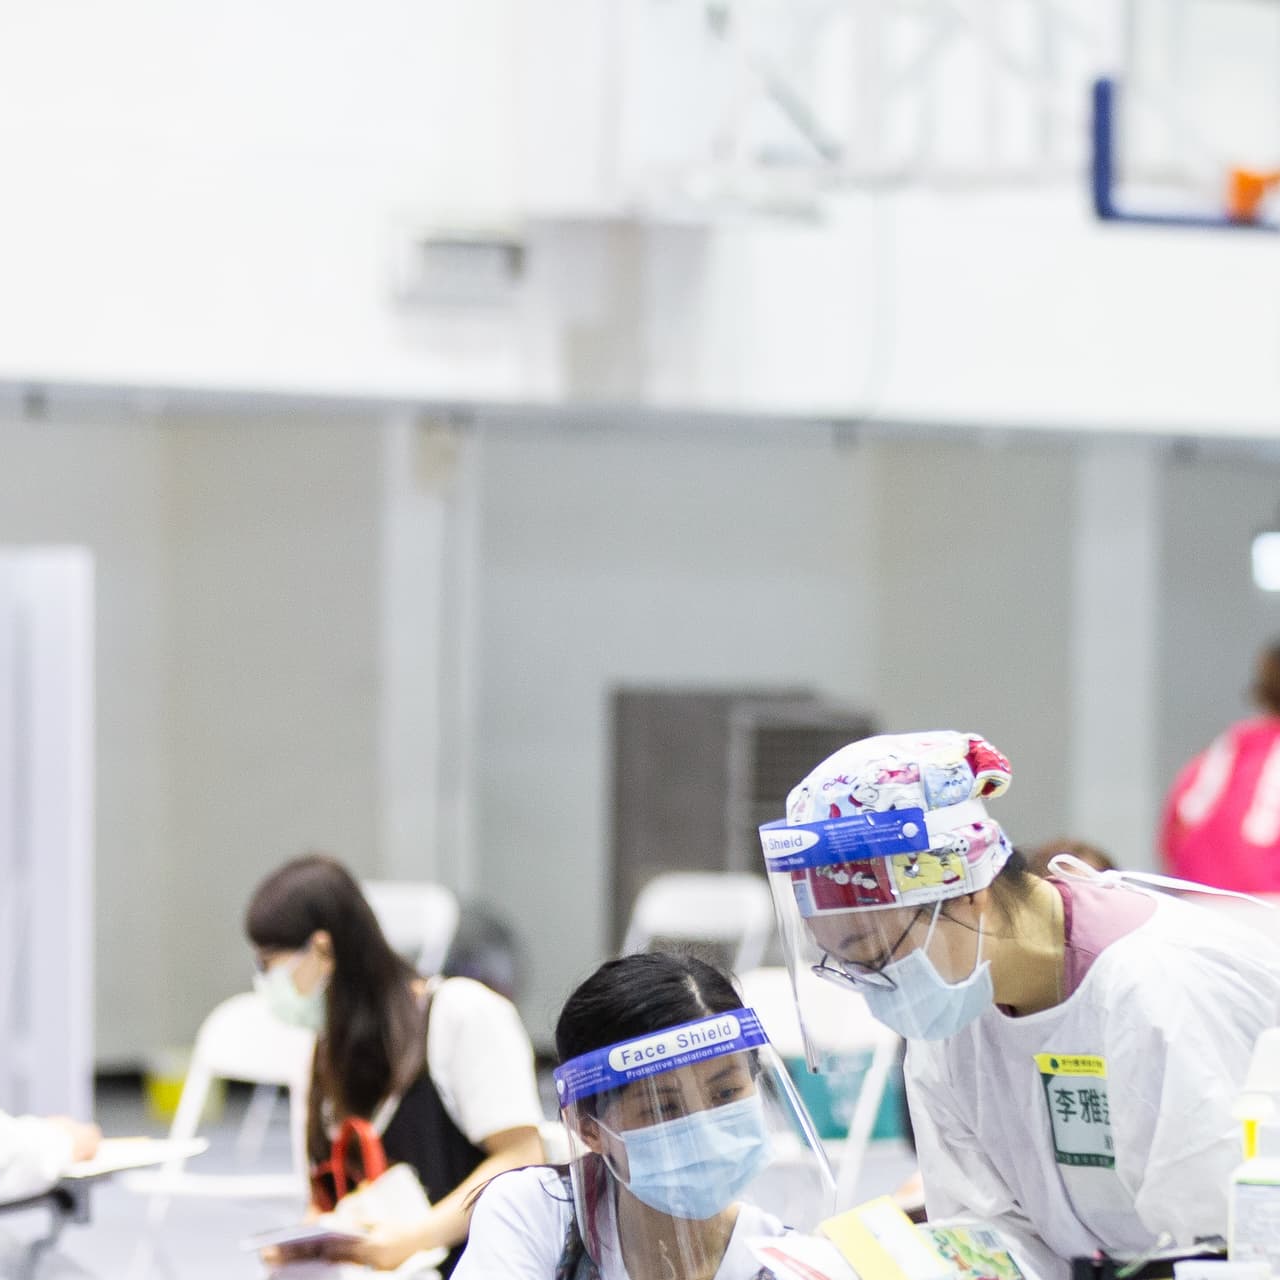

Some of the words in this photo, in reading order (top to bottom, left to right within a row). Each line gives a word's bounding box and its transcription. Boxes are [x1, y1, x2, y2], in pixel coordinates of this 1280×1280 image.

[768, 834, 803, 850] Shield
[621, 1042, 666, 1065] Face
[676, 1022, 732, 1049] Shield
[625, 1060, 673, 1080] Protective
